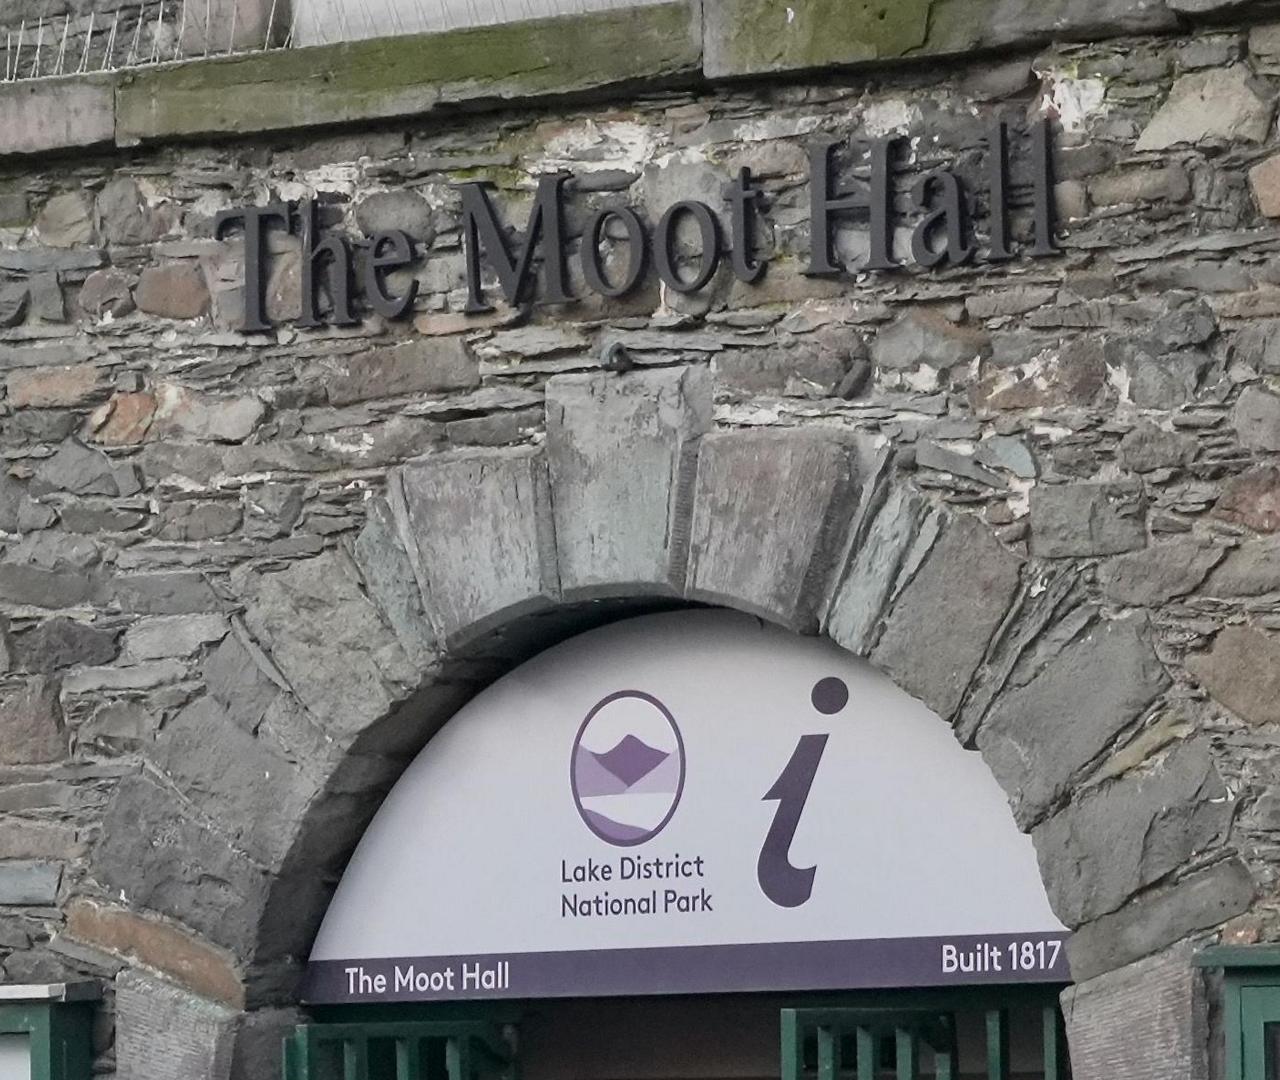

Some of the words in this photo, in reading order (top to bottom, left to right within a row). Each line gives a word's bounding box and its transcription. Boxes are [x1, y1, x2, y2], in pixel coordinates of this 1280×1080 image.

[215, 194, 422, 333] The
[453, 166, 767, 315] Moot
[800, 118, 1070, 277] Hall
[561, 859, 613, 883] Lake
[619, 856, 705, 880] District
[561, 891, 657, 917] National
[663, 888, 713, 913] Park
[941, 944, 1001, 973] Built
[1007, 941, 1062, 971] 1817
[344, 966, 387, 995] The
[394, 964, 455, 992] Moot
[462, 962, 510, 990] Hall
